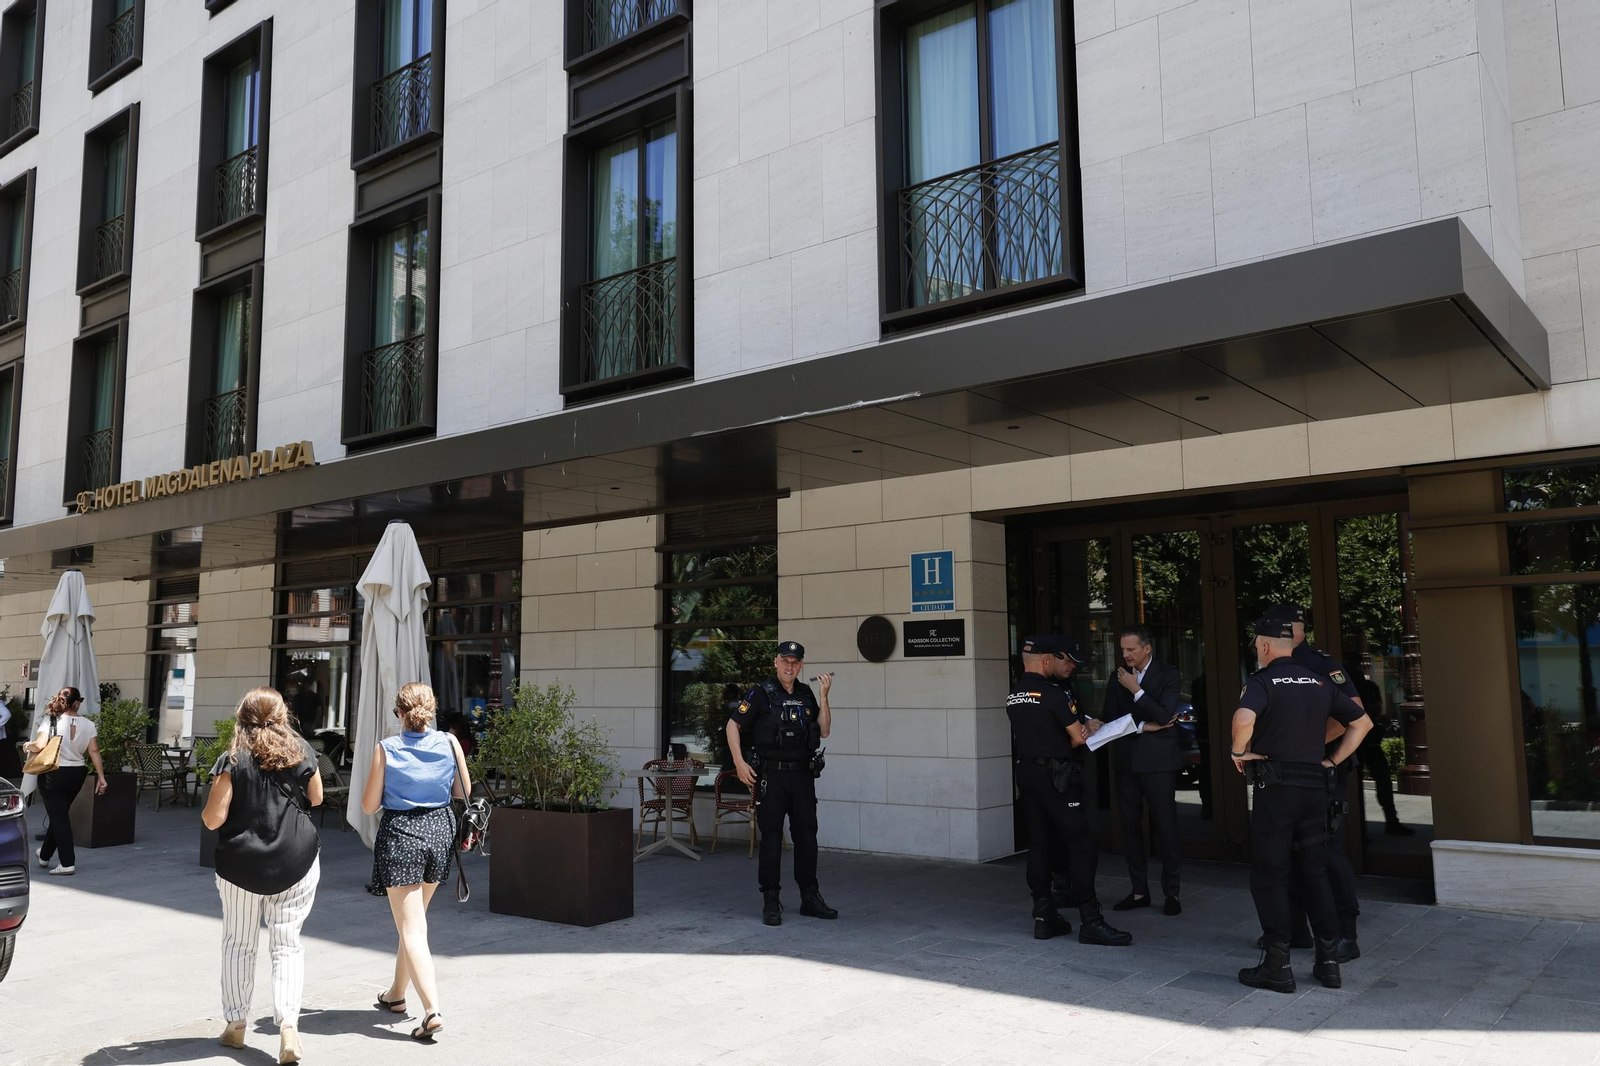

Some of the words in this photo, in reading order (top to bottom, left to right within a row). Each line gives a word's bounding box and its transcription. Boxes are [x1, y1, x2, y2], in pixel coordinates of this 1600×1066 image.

[94, 480, 142, 511] HOTEL
[143, 456, 249, 501] MAGDALENA
[250, 440, 316, 477] PLAZA
[922, 556, 943, 586] H
[920, 603, 946, 611] CIUDAD
[1271, 677, 1320, 686] POLICIA
